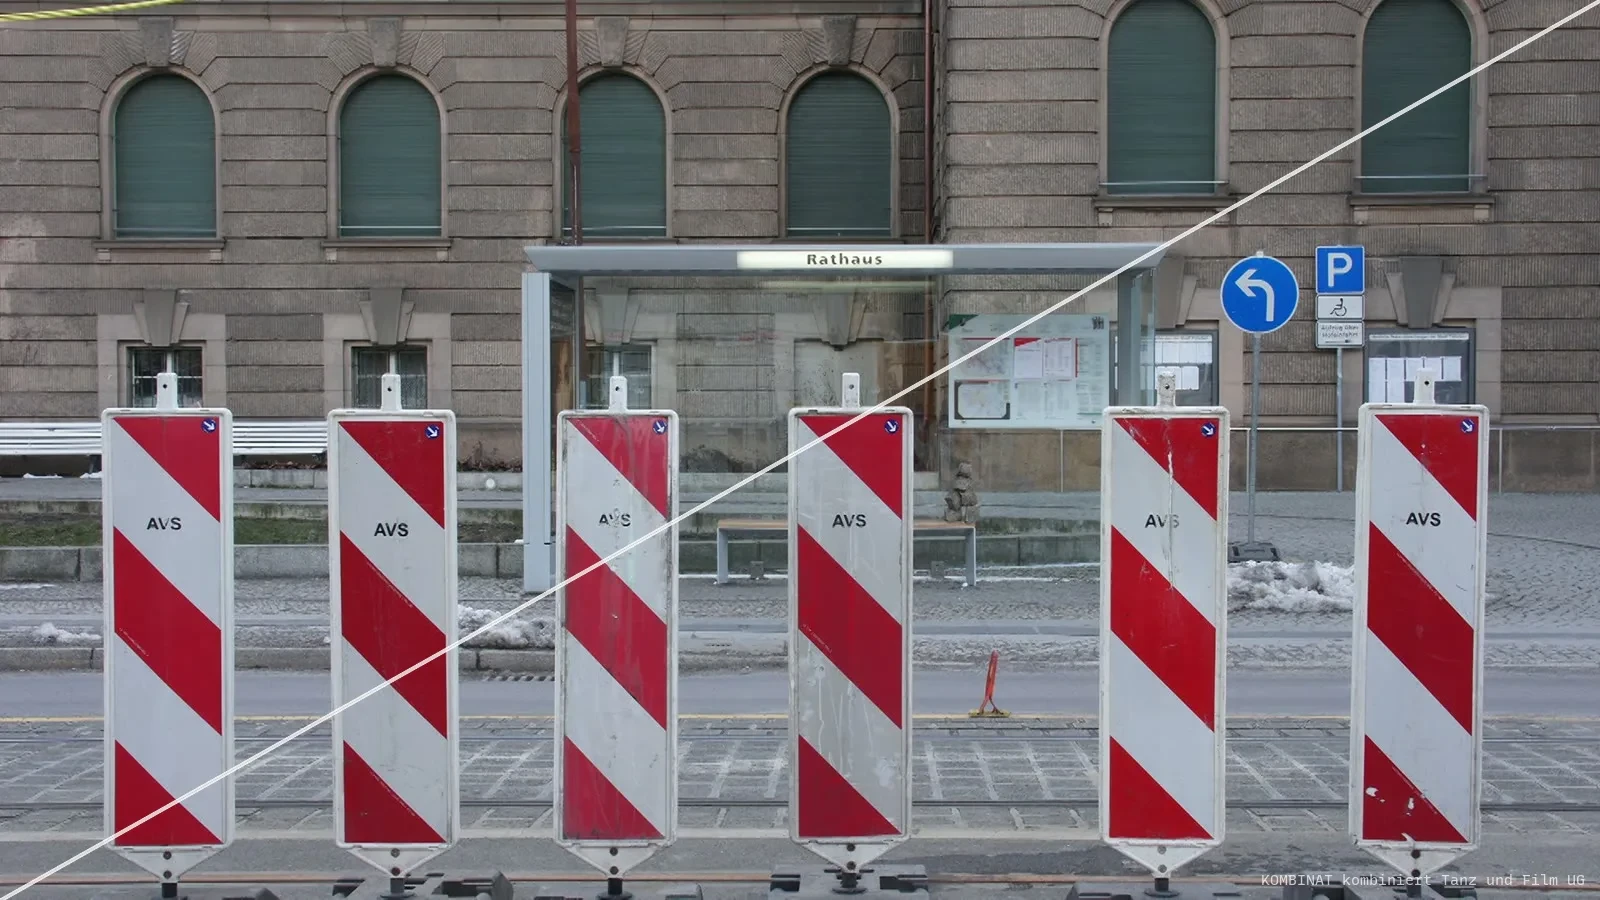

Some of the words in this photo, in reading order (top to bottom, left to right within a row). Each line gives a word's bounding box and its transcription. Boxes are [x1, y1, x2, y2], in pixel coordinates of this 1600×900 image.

[806, 252, 883, 266] Rathaus
[1327, 252, 1353, 288] P
[146, 517, 182, 531] AVS
[832, 513, 867, 528] AVS
[1405, 512, 1441, 526] AVS
[373, 522, 409, 537] AVS
